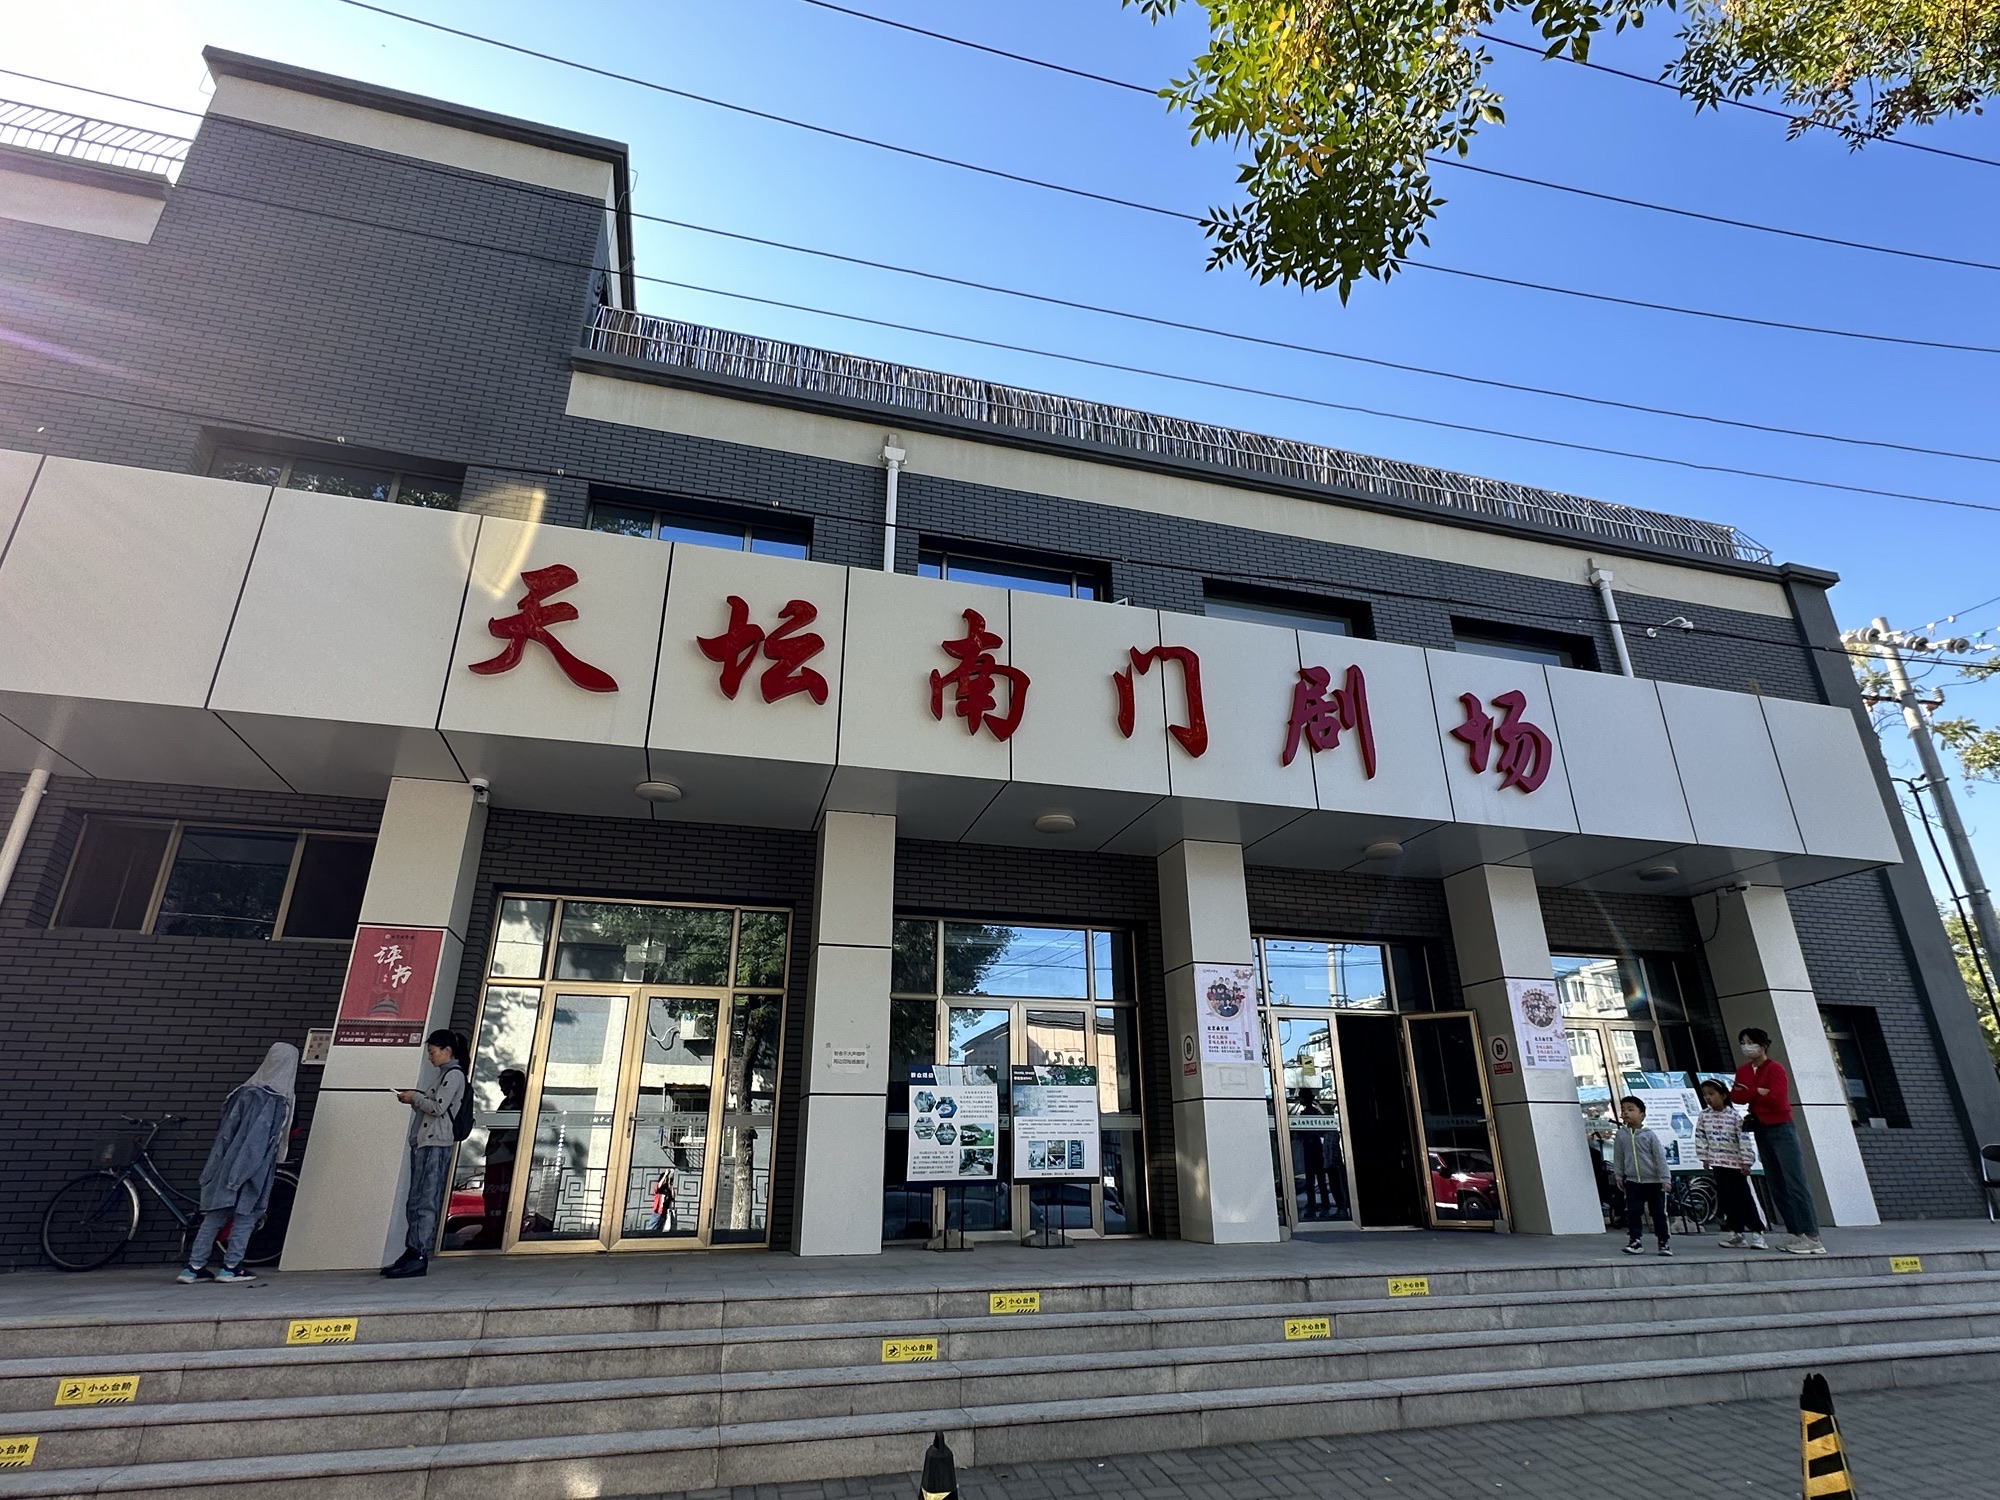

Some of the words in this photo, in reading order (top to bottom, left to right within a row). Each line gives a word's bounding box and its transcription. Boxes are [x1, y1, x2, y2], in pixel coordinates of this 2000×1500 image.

[468, 564, 1553, 793] 天坛南门剧场
[374, 944, 412, 988] 评书
[313, 1323, 352, 1333] 小心台阶
[902, 1343, 933, 1352] 小心台阶
[87, 1381, 133, 1392] 小心台阶
